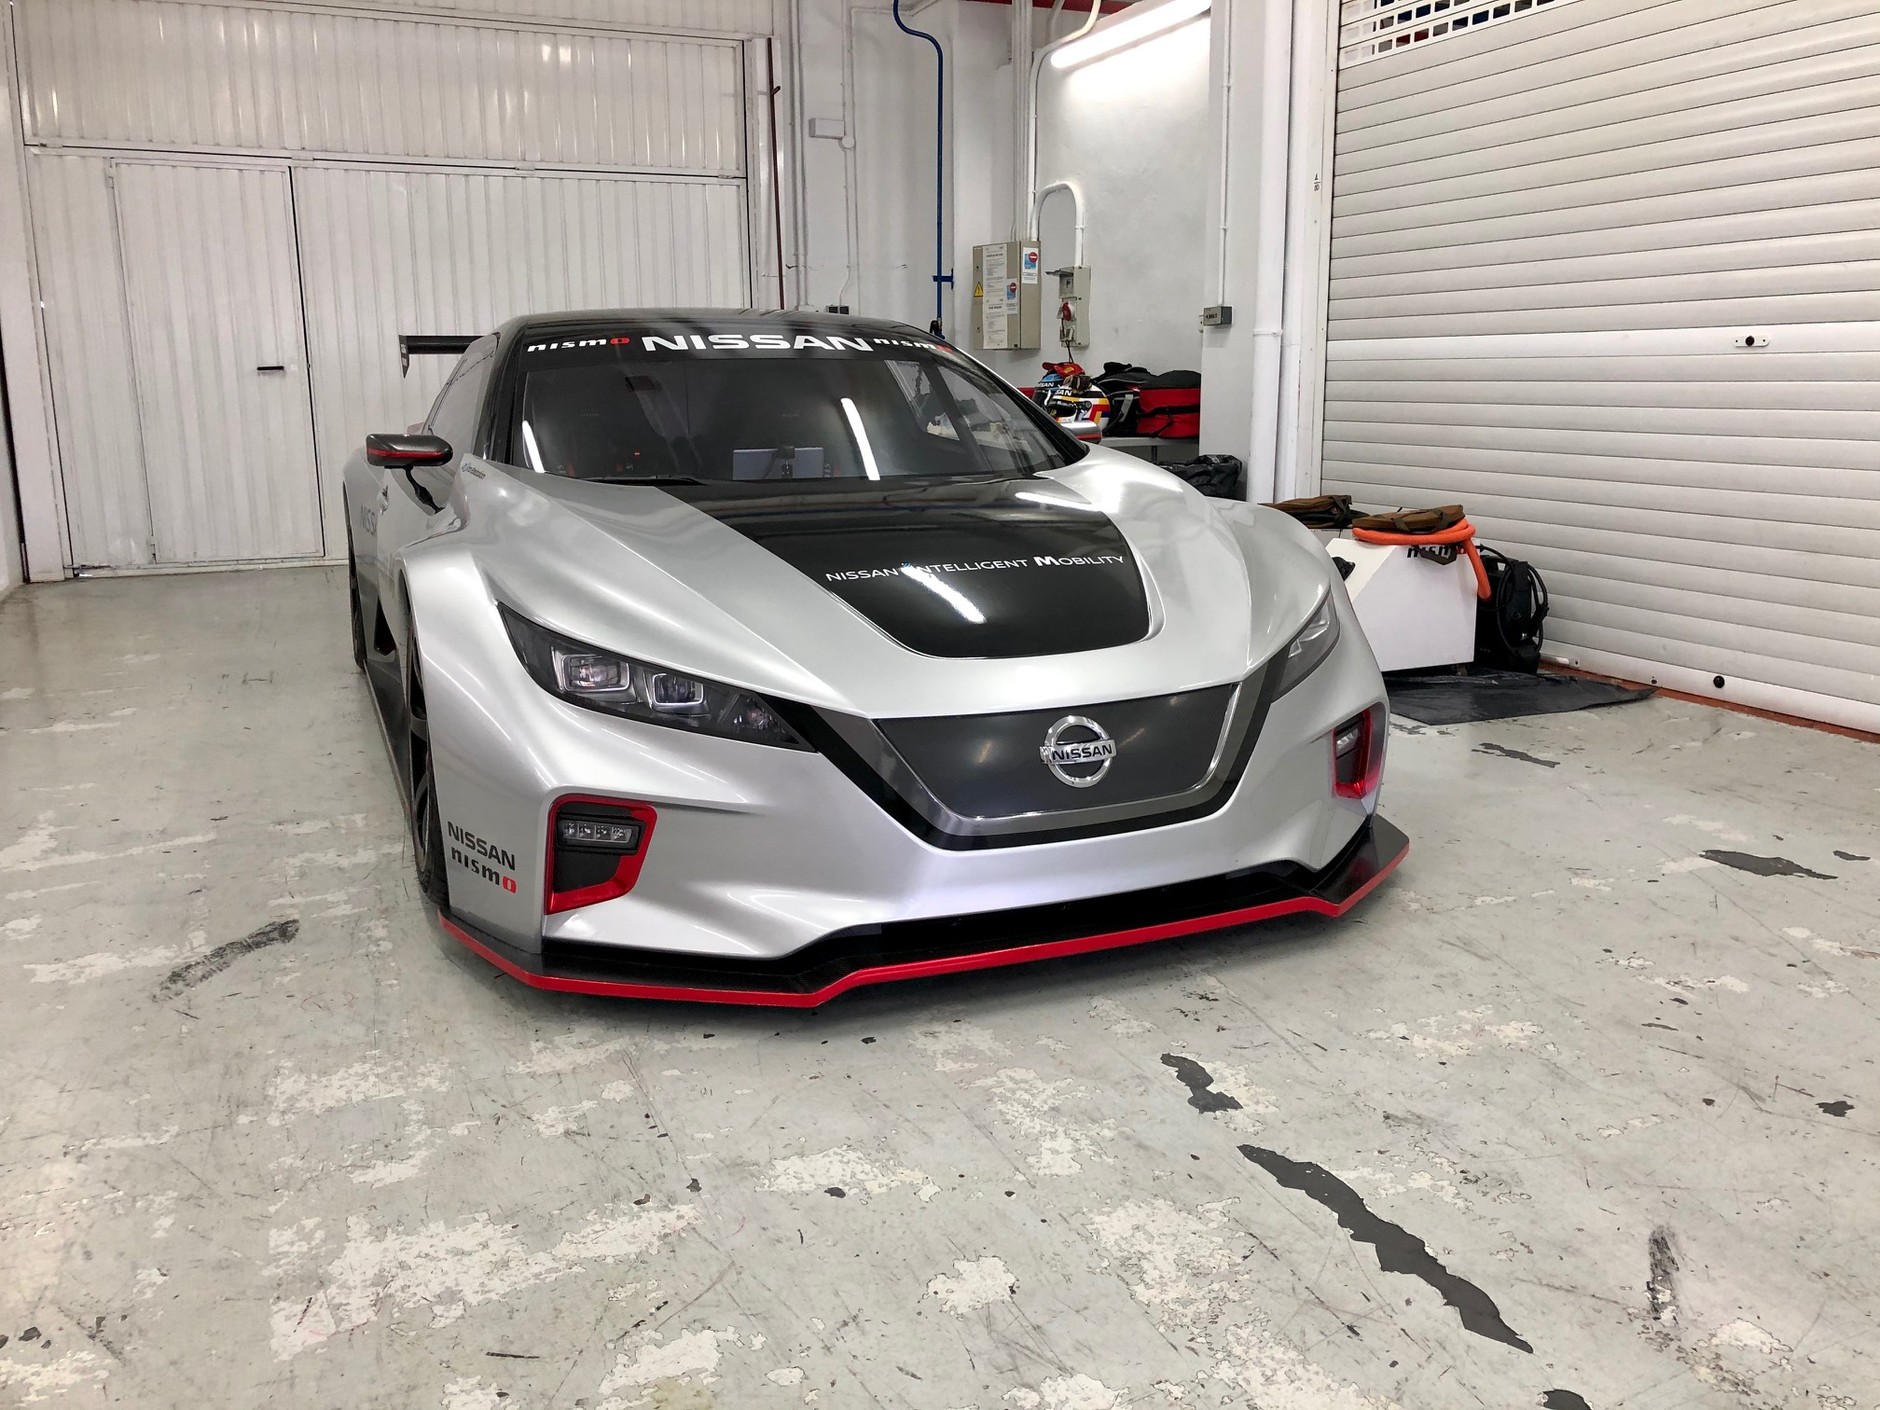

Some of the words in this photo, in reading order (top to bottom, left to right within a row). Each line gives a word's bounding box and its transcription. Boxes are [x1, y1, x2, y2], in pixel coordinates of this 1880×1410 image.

[527, 338, 630, 352] nismo
[641, 334, 874, 351] NISSAN
[825, 567, 899, 582] NISSAN
[908, 559, 1027, 574] NTELLIGENT
[1033, 555, 1124, 567] MOBILITY
[1051, 743, 1113, 760] NISSAN
[447, 821, 516, 871] NISSAN
[451, 846, 517, 894] nismo
